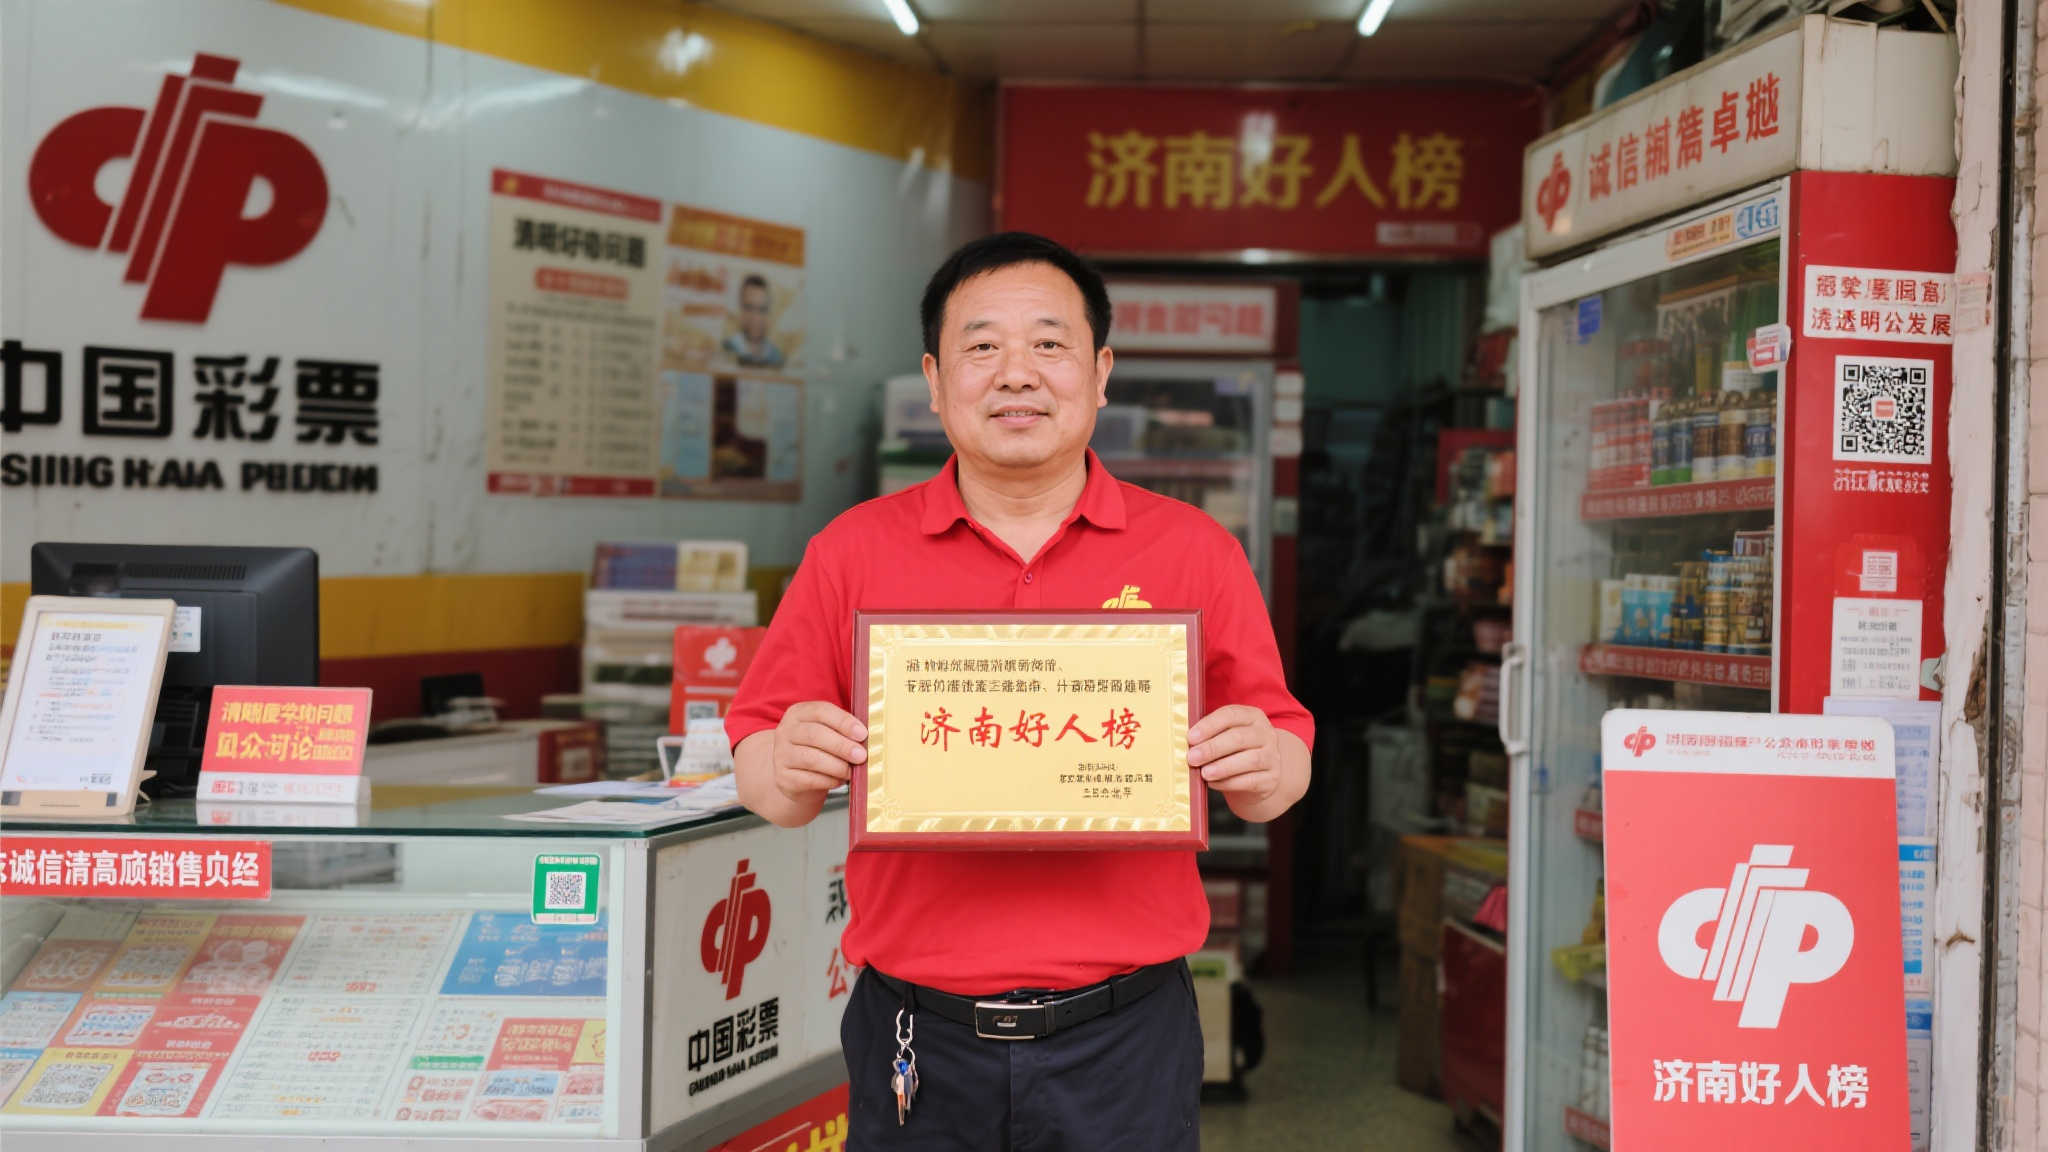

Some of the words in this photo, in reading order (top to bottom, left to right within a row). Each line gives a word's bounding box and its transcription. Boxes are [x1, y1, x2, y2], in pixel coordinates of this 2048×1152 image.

[1086, 131, 1464, 210] 济南好人榜
[0, 340, 380, 445] 中国彩票
[920, 706, 1141, 752] 济南好人榜
[688, 997, 779, 1072] 中国彩票
[1653, 1059, 1870, 1109] 济南好人榜
